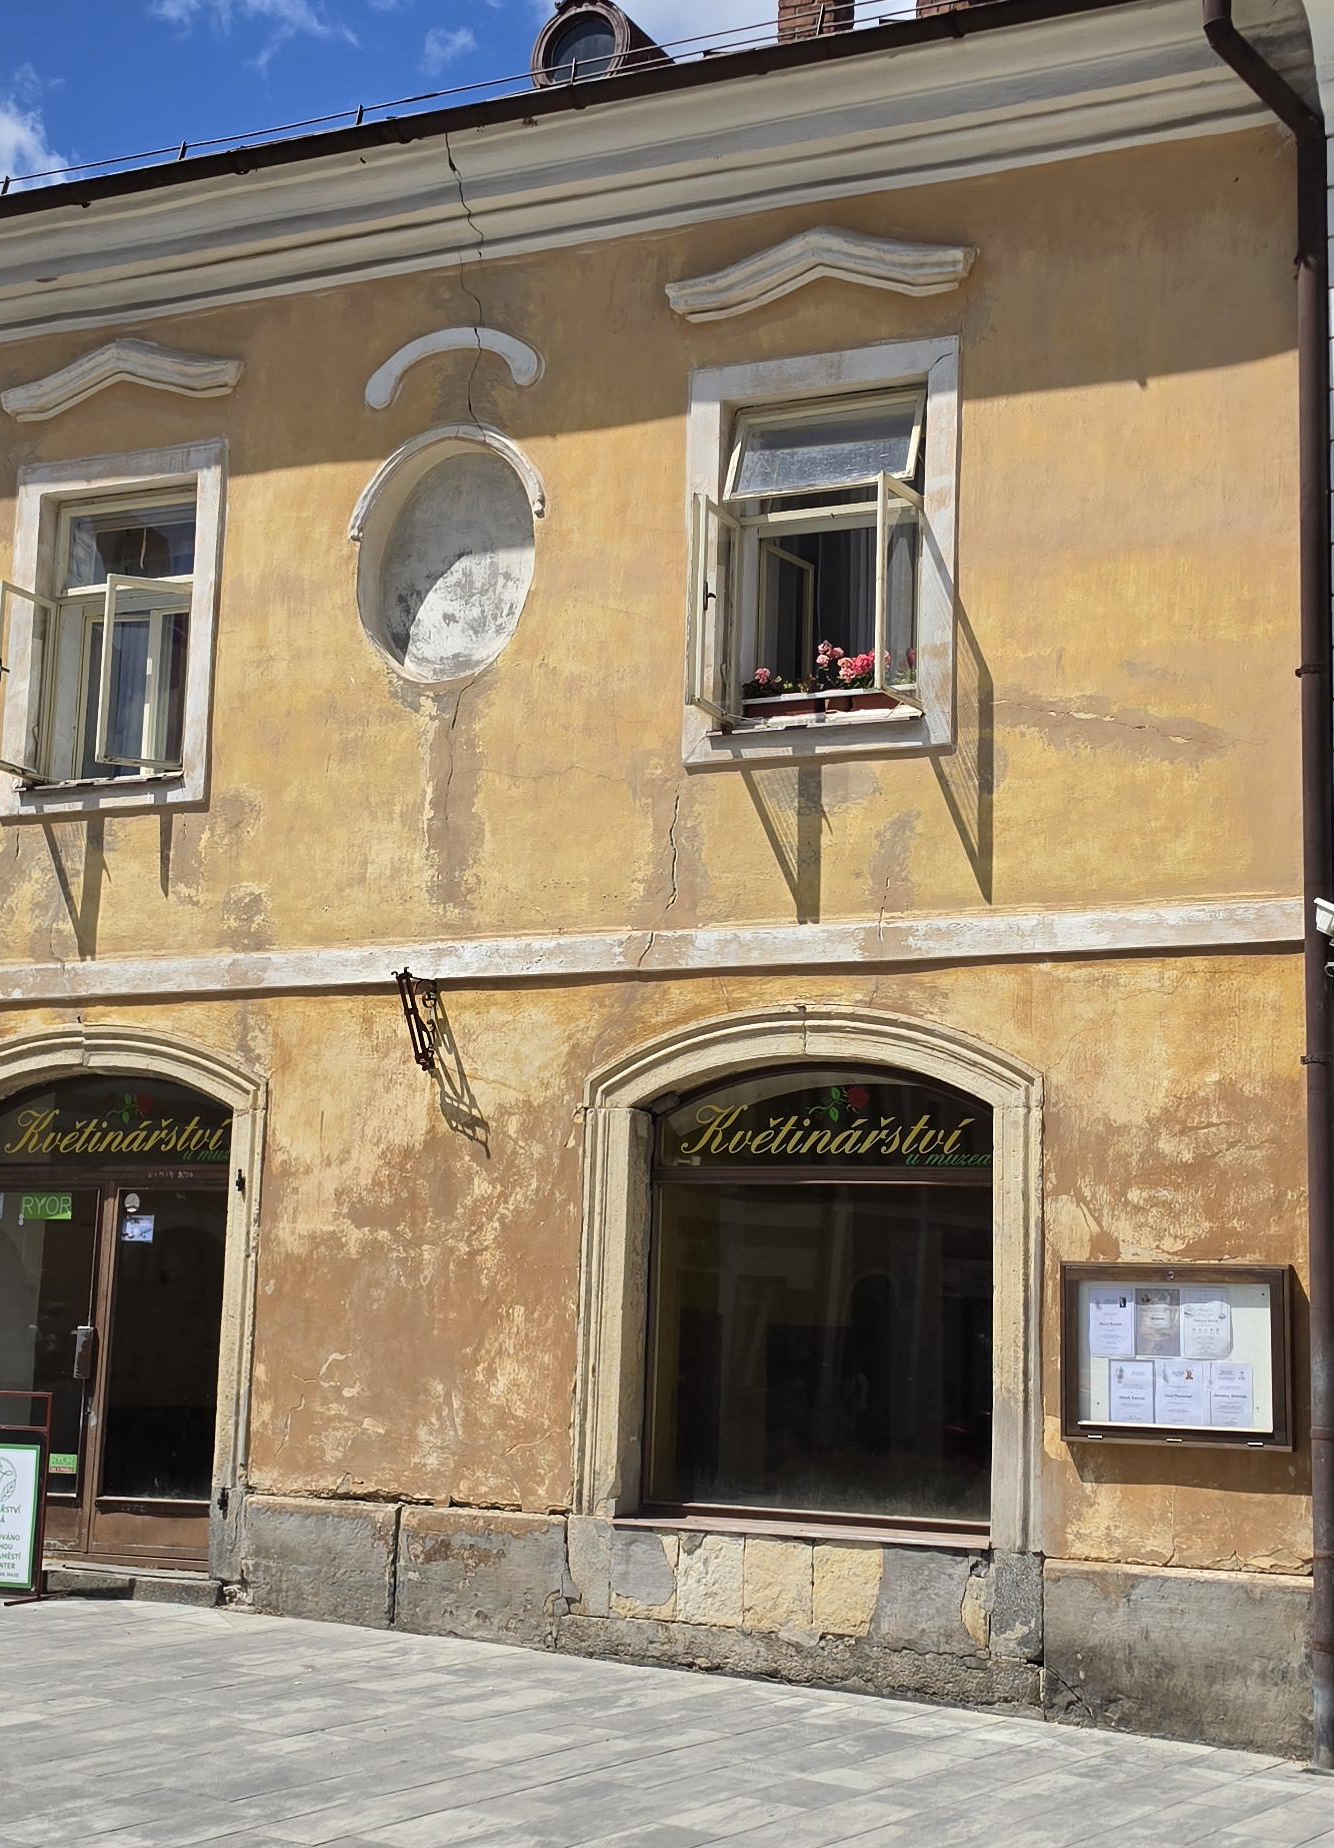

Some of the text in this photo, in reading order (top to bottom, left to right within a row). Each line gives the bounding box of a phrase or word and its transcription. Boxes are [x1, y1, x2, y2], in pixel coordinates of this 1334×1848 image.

[4, 1108, 232, 1154] Květinářství
[680, 1103, 975, 1155] Květinářství
[905, 1152, 991, 1166] u muzea
[21, 1195, 72, 1215] RYOR
